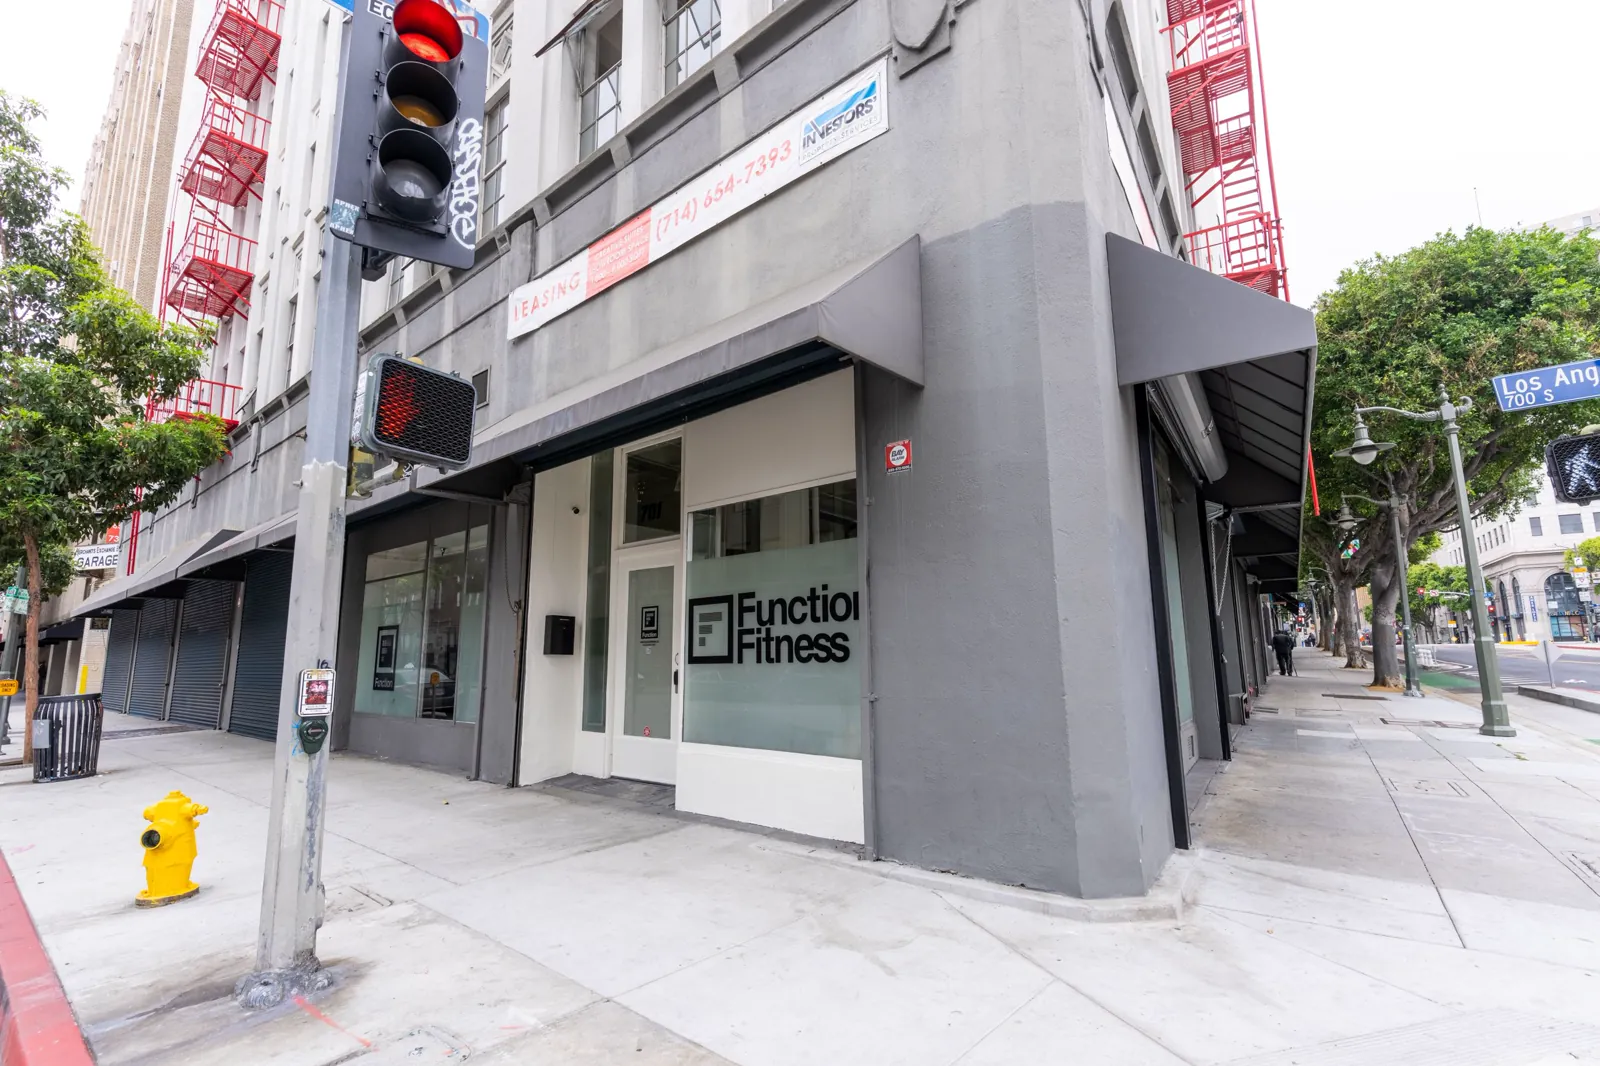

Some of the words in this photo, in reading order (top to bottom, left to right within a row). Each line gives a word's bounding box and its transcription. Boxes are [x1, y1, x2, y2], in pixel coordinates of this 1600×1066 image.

[656, 197, 698, 242] (714)
[703, 139, 792, 209] 654-7393
[514, 271, 581, 322] LEASING
[1501, 376, 1542, 396] Los
[1555, 366, 1600, 387] Ang
[1504, 392, 1536, 408] 700
[1543, 389, 1555, 402] S
[891, 449, 905, 457] BAY
[77, 555, 119, 568] GARAGE
[737, 627, 850, 664] Fitness
